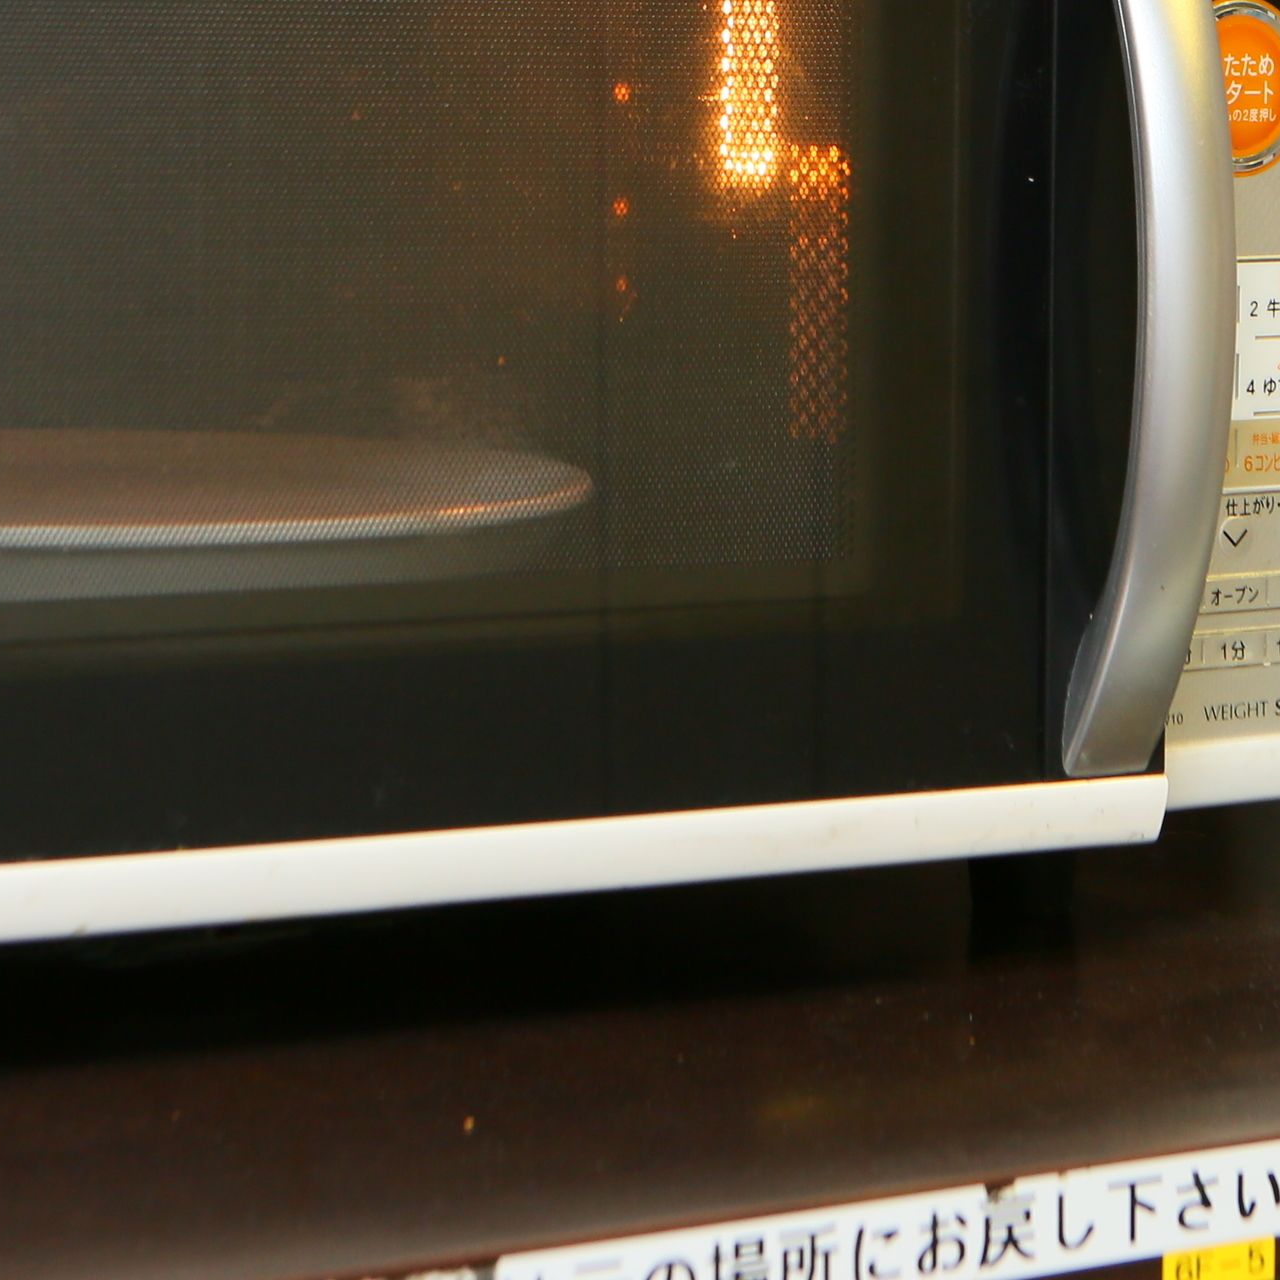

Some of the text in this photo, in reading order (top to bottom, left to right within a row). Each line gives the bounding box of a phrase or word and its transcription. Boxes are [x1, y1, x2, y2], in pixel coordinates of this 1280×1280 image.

[1228, 107, 1277, 123] の2度押し
[1249, 300, 1259, 317] 2
[1246, 379, 1256, 395] 4
[1210, 586, 1260, 606] オープン
[1220, 639, 1246, 661] 1分
[1204, 699, 1269, 721] WEIGHT
